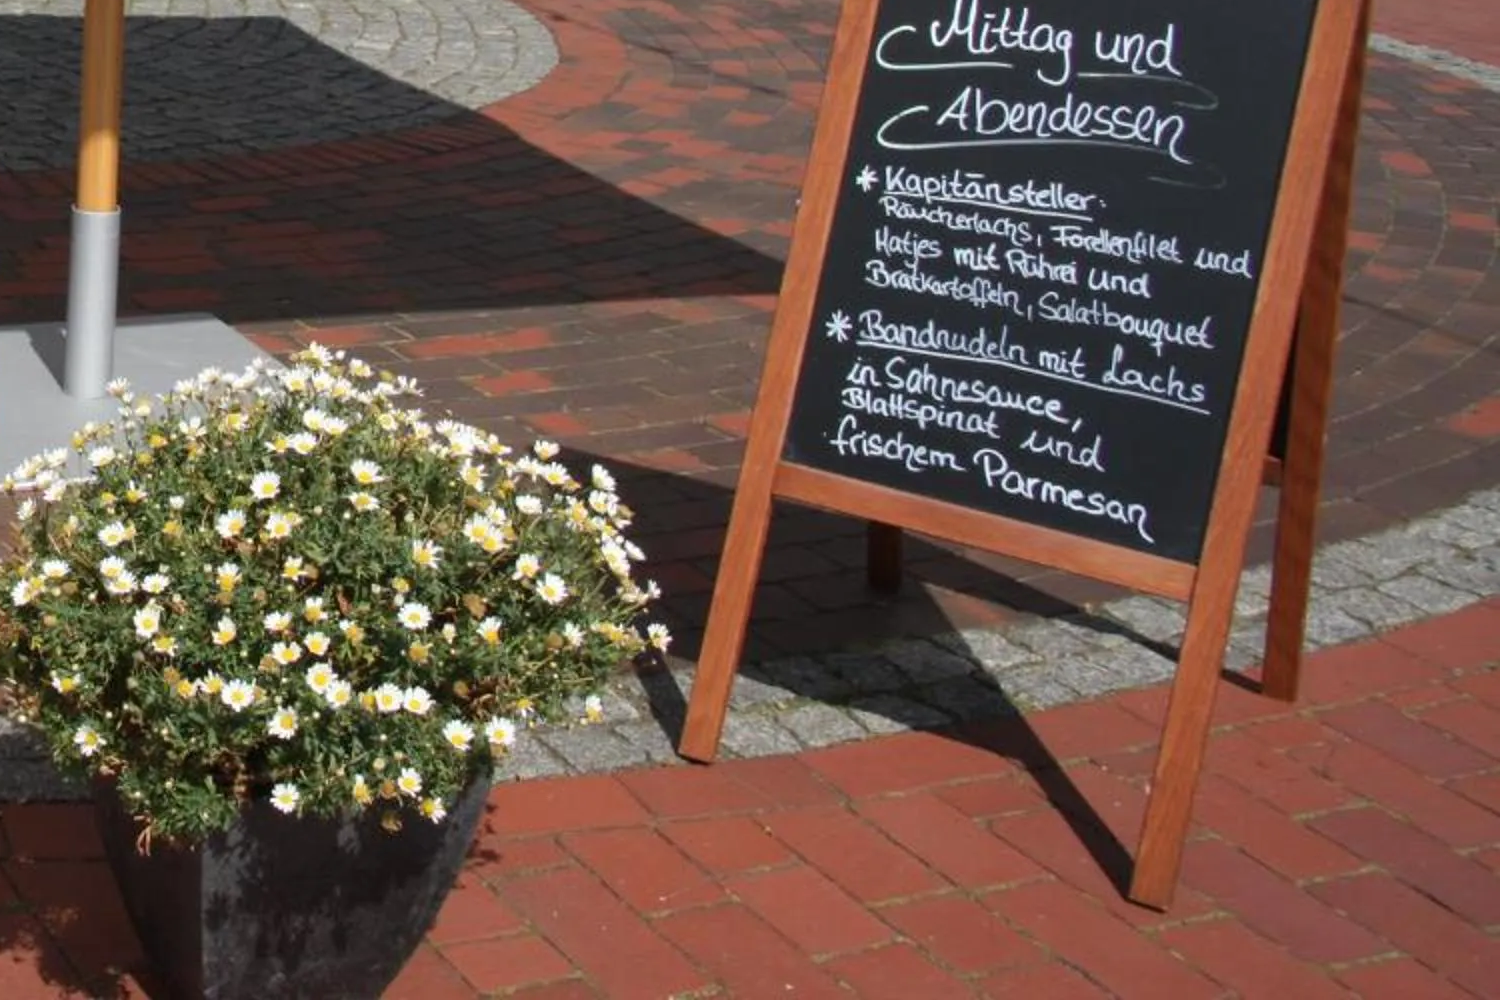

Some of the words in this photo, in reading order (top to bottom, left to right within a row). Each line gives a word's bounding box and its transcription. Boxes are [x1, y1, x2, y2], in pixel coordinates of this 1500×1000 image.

[1095, 23, 1184, 77] und
[936, 86, 1194, 165] Abendessen
[953, 242, 1001, 271] mit
[1088, 267, 1152, 299] und
[1194, 247, 1254, 279] und
[858, 309, 1030, 365] Bandnudeln
[1038, 347, 1086, 379] mit
[1102, 343, 1206, 403] Lachs
[1037, 291, 1217, 358] Salatbouquet
[846, 356, 881, 387] in
[841, 386, 1001, 440] Blattspinat
[1019, 430, 1106, 473] und
[830, 414, 967, 474] frischem
[972, 448, 1155, 544] Parmesan
